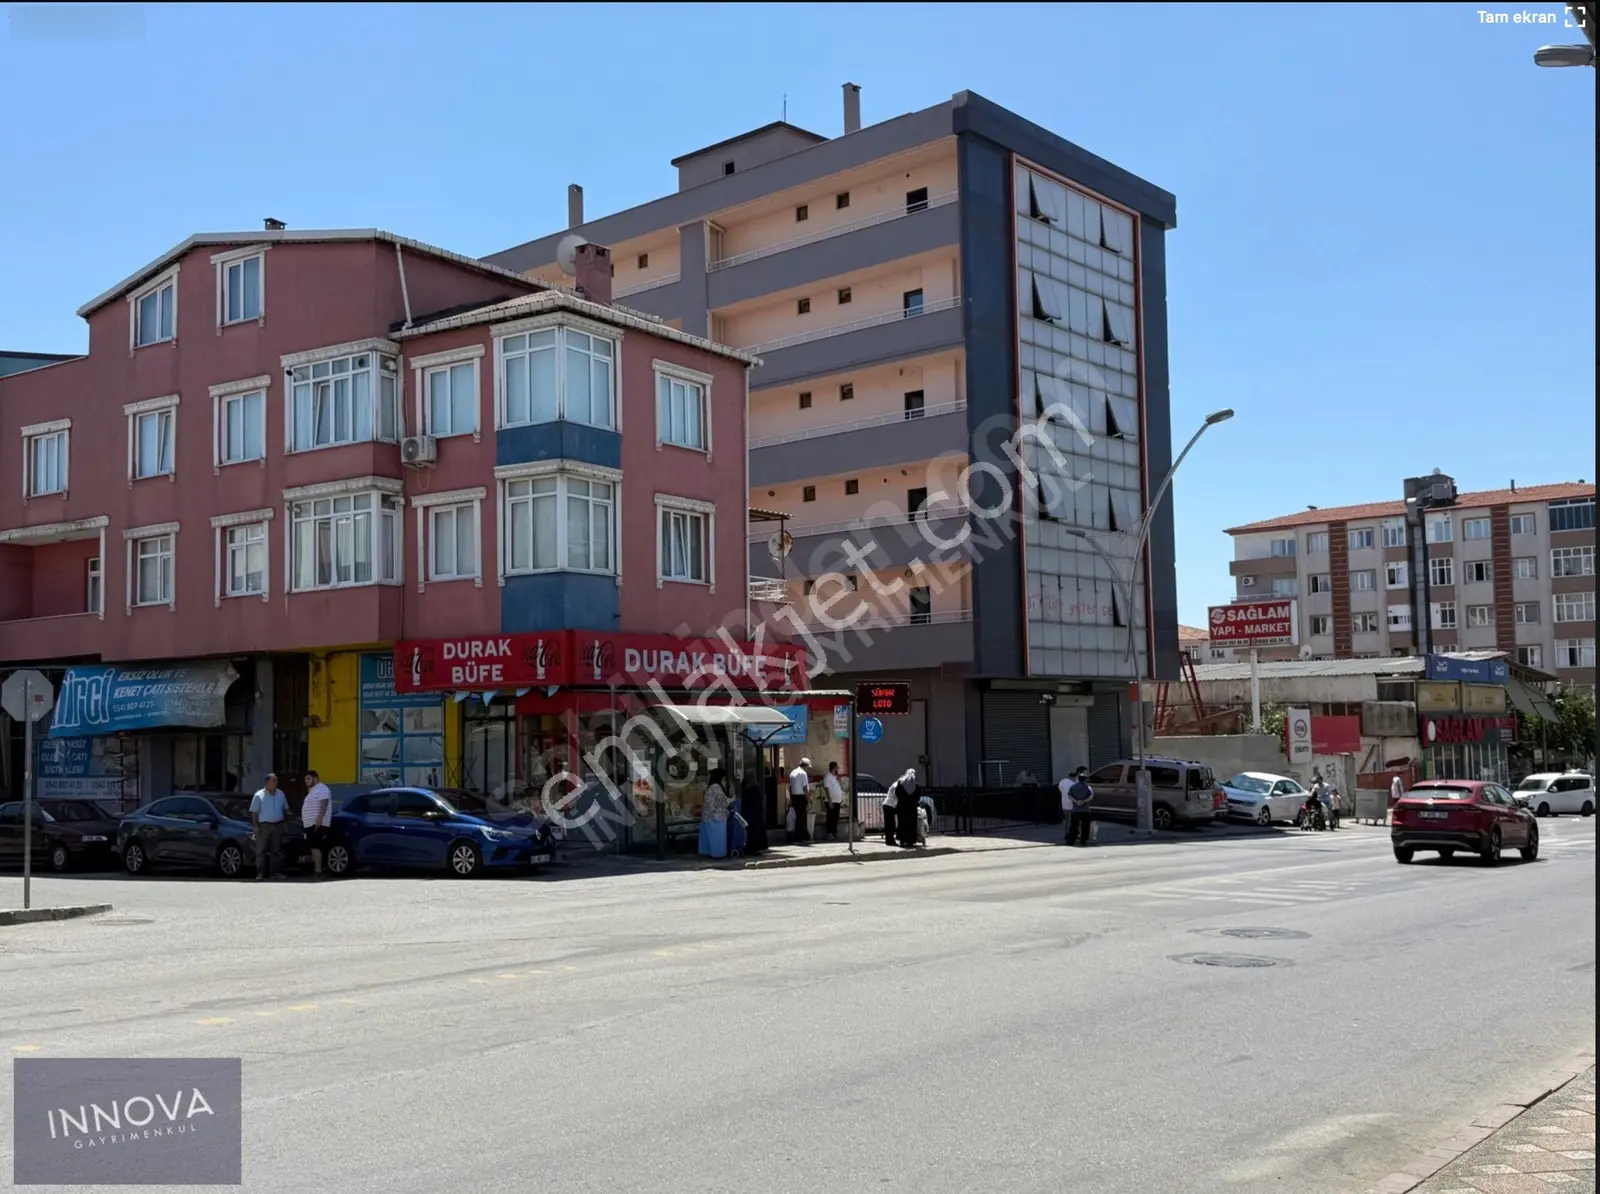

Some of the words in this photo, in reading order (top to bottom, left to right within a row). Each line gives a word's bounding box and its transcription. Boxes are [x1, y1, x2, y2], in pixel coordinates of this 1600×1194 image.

[1227, 605, 1290, 622] SAĞLAM
[1211, 625, 1236, 636] YAPI
[1244, 622, 1290, 635] MARKET
[443, 638, 512, 660] DURAK
[452, 660, 503, 684] BÜFE
[624, 648, 706, 674] DURAK
[712, 648, 767, 678] BÜFE
[873, 699, 892, 708] LOTO
